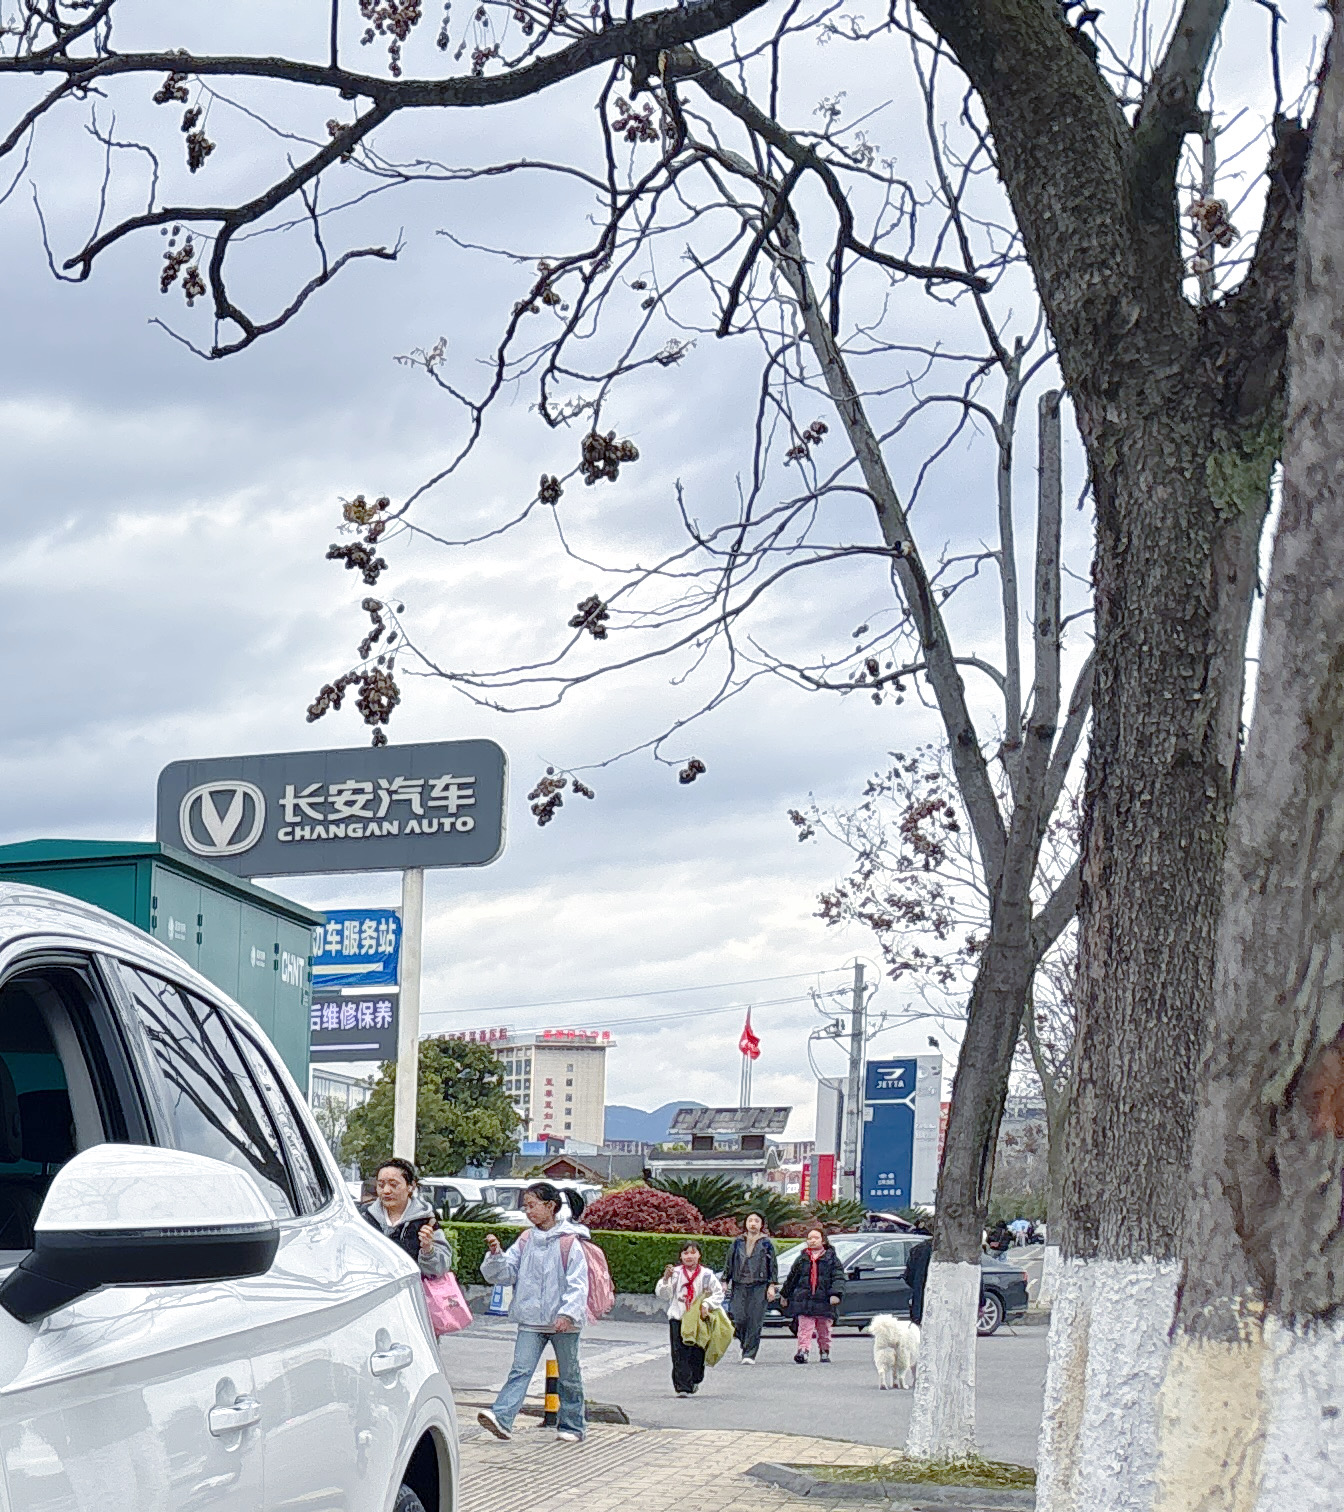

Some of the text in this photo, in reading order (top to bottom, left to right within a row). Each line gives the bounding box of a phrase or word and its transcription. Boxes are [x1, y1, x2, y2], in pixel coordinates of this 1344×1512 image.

[278, 773, 476, 823] 长安汽车
[277, 815, 476, 842] CHANGAN AUTO
[875, 1079, 905, 1089] JETTA
